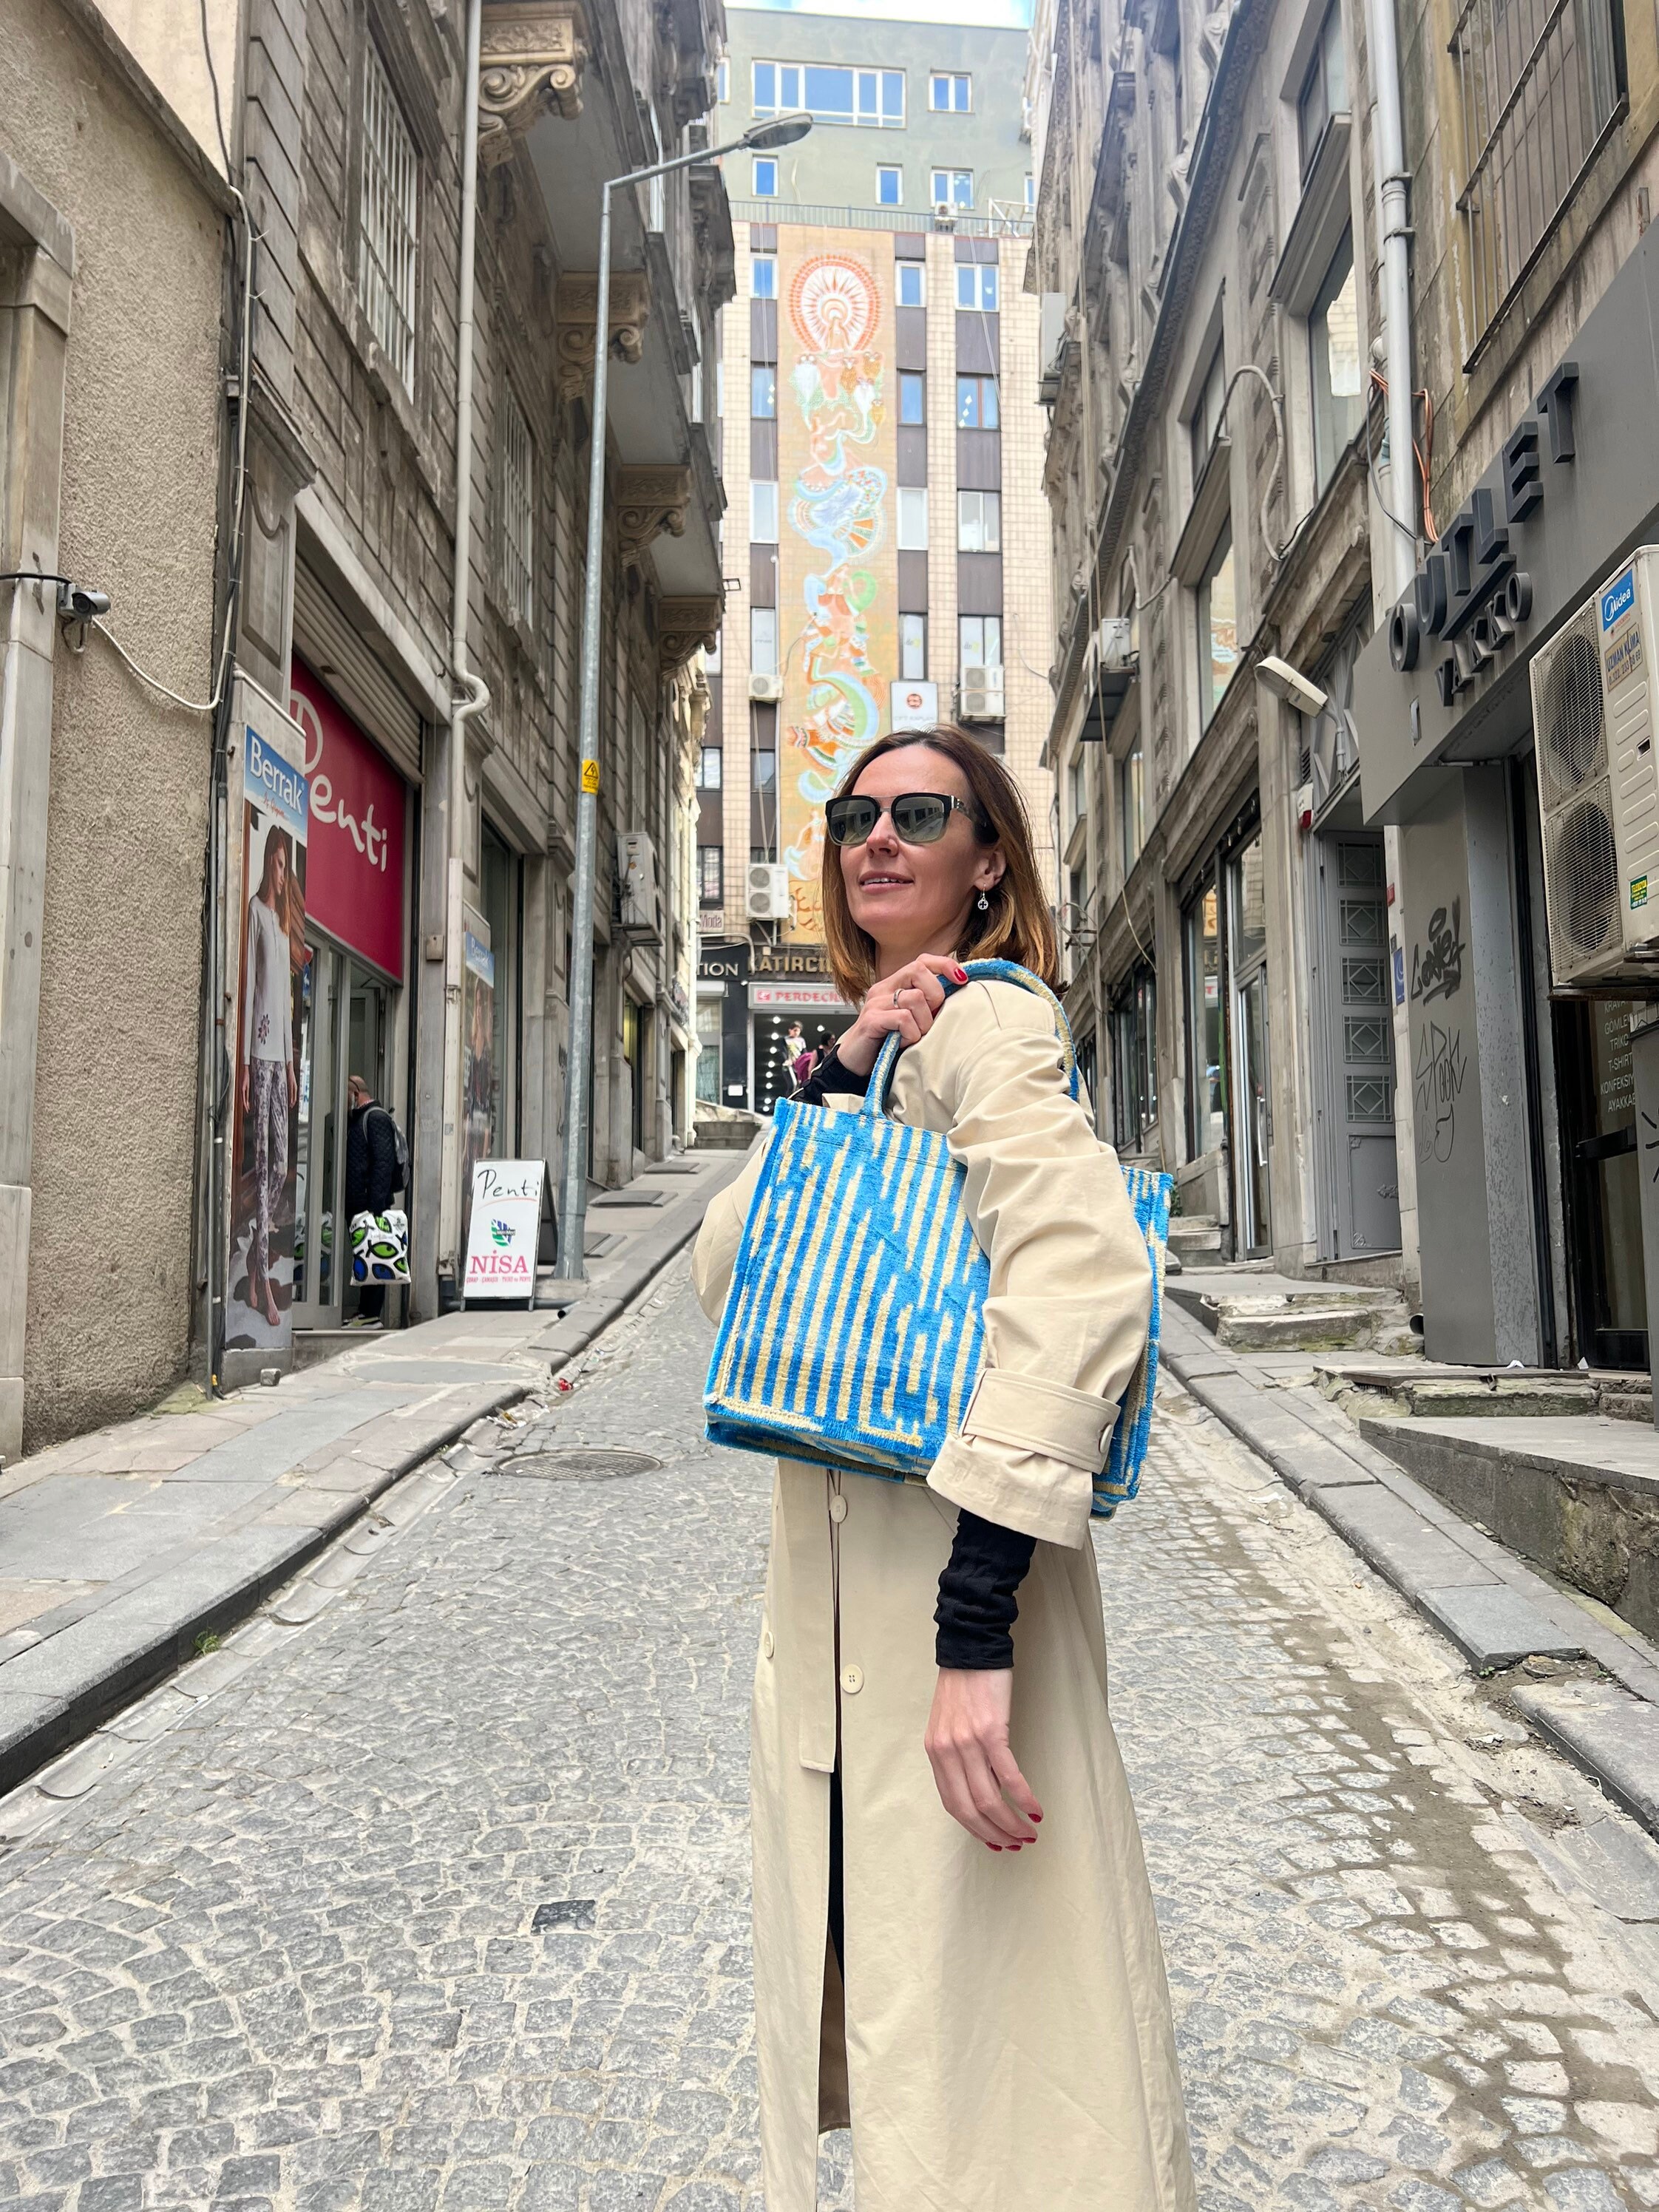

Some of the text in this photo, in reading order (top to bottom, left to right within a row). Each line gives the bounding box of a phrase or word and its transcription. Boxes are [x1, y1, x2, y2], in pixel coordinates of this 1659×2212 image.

[1388, 362, 1579, 673] OUTLET
[1604, 588, 1631, 622] Midea
[1435, 572, 1533, 707] VAKKO
[1607, 643, 1624, 672] UZMAN
[251, 735, 302, 815] Berrak
[1608, 1052, 1632, 1073] T-SHIRT
[478, 1169, 540, 1200] Penti
[469, 1249, 529, 1275] NİSA
